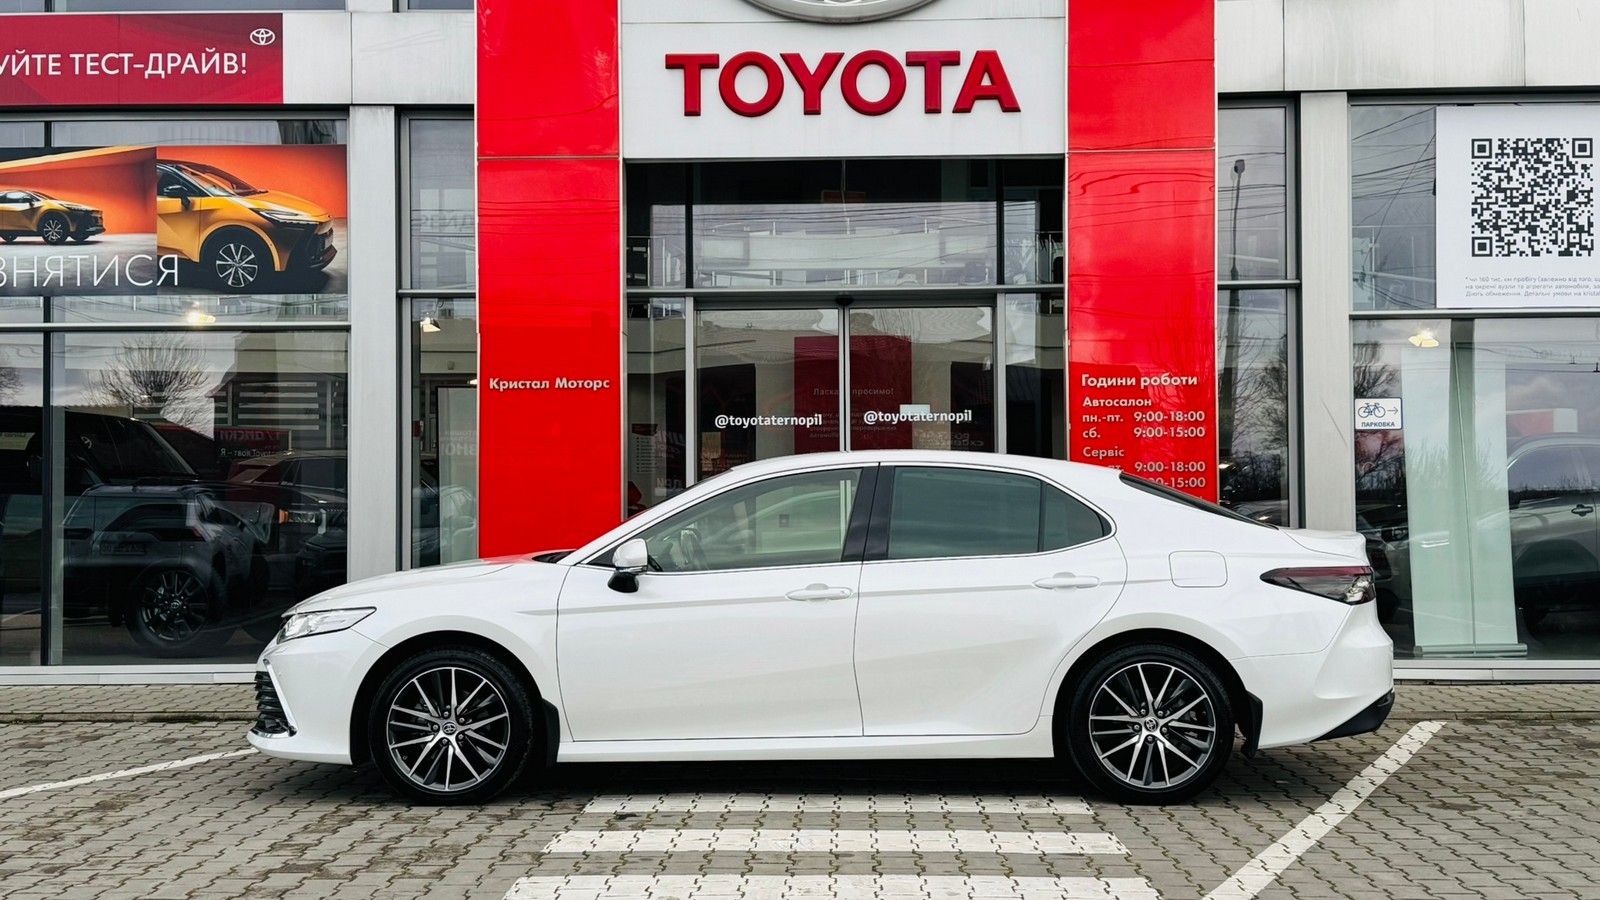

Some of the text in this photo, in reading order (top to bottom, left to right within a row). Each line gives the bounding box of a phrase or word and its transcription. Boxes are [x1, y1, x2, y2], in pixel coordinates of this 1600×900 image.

[69, 47, 247, 79] ТЕСТ-ДРАЙВ!
[665, 49, 1021, 117] TOYOTA
[489, 377, 610, 392] Кристал Моторс
[1081, 372, 1198, 389] Години роботи
[852, 388, 894, 396] просимо!
[1082, 396, 1152, 407] Автосалон
[714, 413, 823, 428] @toyotaternopil
[863, 409, 973, 424] @toyotaternopil
[1133, 410, 1206, 422] 9:00-18:00
[1082, 426, 1206, 438] сб. 9:00-15:00
[1083, 445, 1125, 460] Сервіс
[1134, 461, 1206, 473] 9:00-18:00
